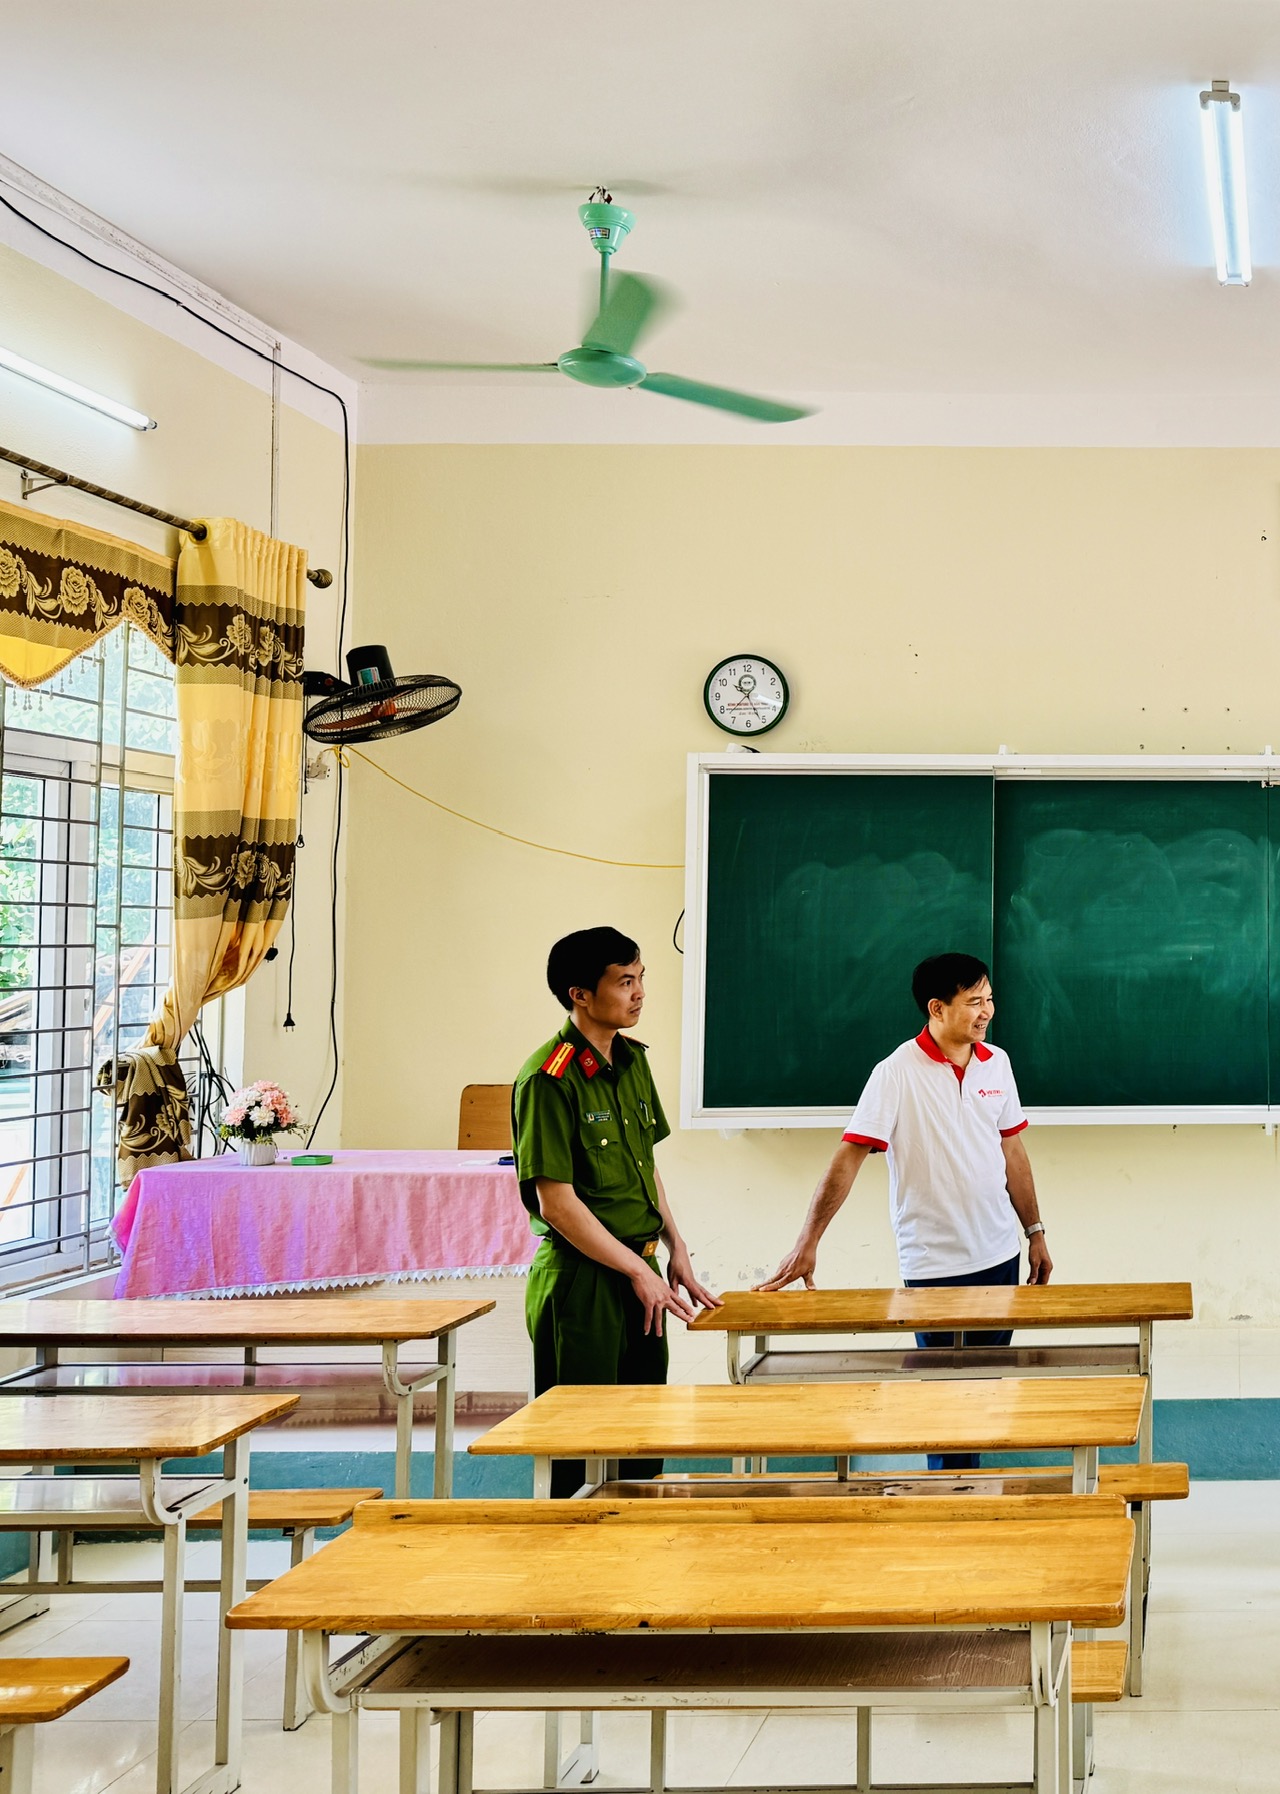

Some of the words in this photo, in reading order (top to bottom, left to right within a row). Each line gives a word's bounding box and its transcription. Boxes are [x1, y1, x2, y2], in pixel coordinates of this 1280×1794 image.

[729, 668, 736, 676] 11
[743, 664, 752, 673] 12
[761, 667, 765, 675] 1
[718, 678, 728, 687] 10
[770, 677, 776, 686] 2
[715, 692, 721, 701] 9
[775, 691, 781, 699] 3
[719, 705, 725, 714] 8
[731, 716, 736, 724] 7
[745, 720, 752, 728] 6
[761, 715, 767, 724] 5
